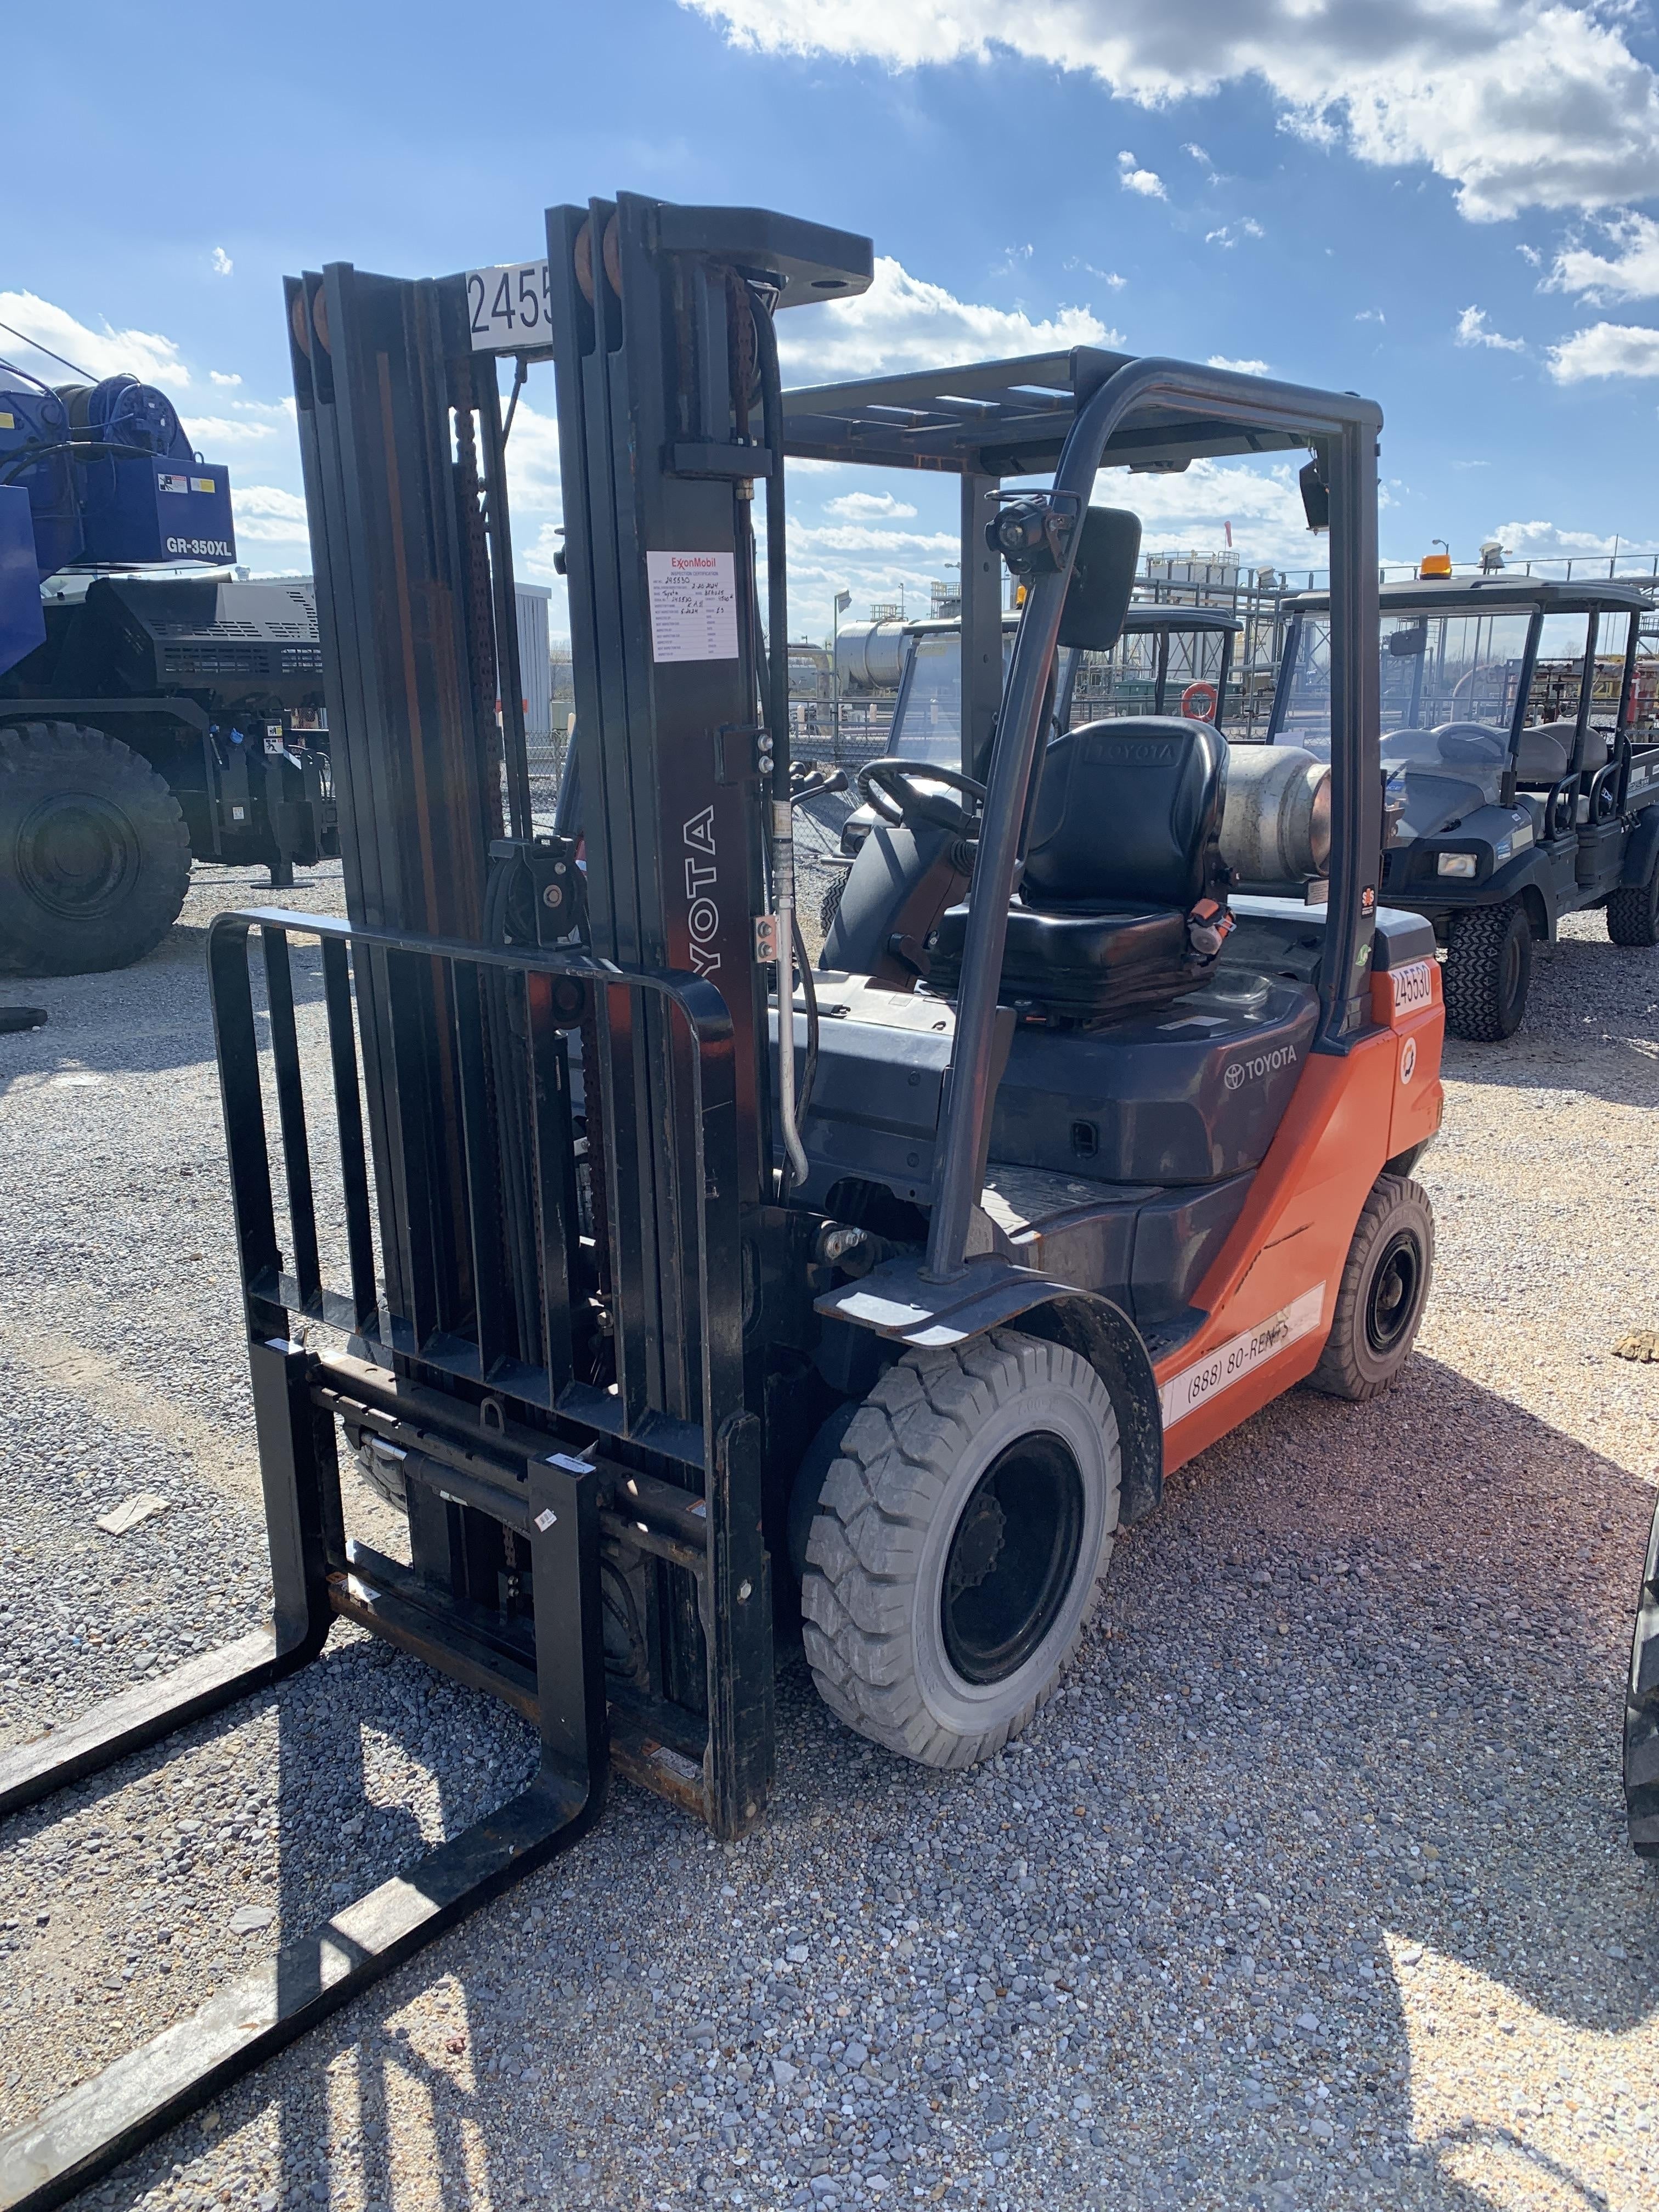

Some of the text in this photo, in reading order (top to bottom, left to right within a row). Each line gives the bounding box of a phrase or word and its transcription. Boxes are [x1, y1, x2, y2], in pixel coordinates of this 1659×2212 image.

[166, 537, 232, 556] GR-350XL
[672, 557, 716, 569] ExxonMobil
[1096, 743, 1174, 760] TOYOTA
[1391, 964, 1430, 1007] 245530
[1245, 1045, 1297, 1080] TOYOTA
[1187, 1361, 1222, 1404] (888)
